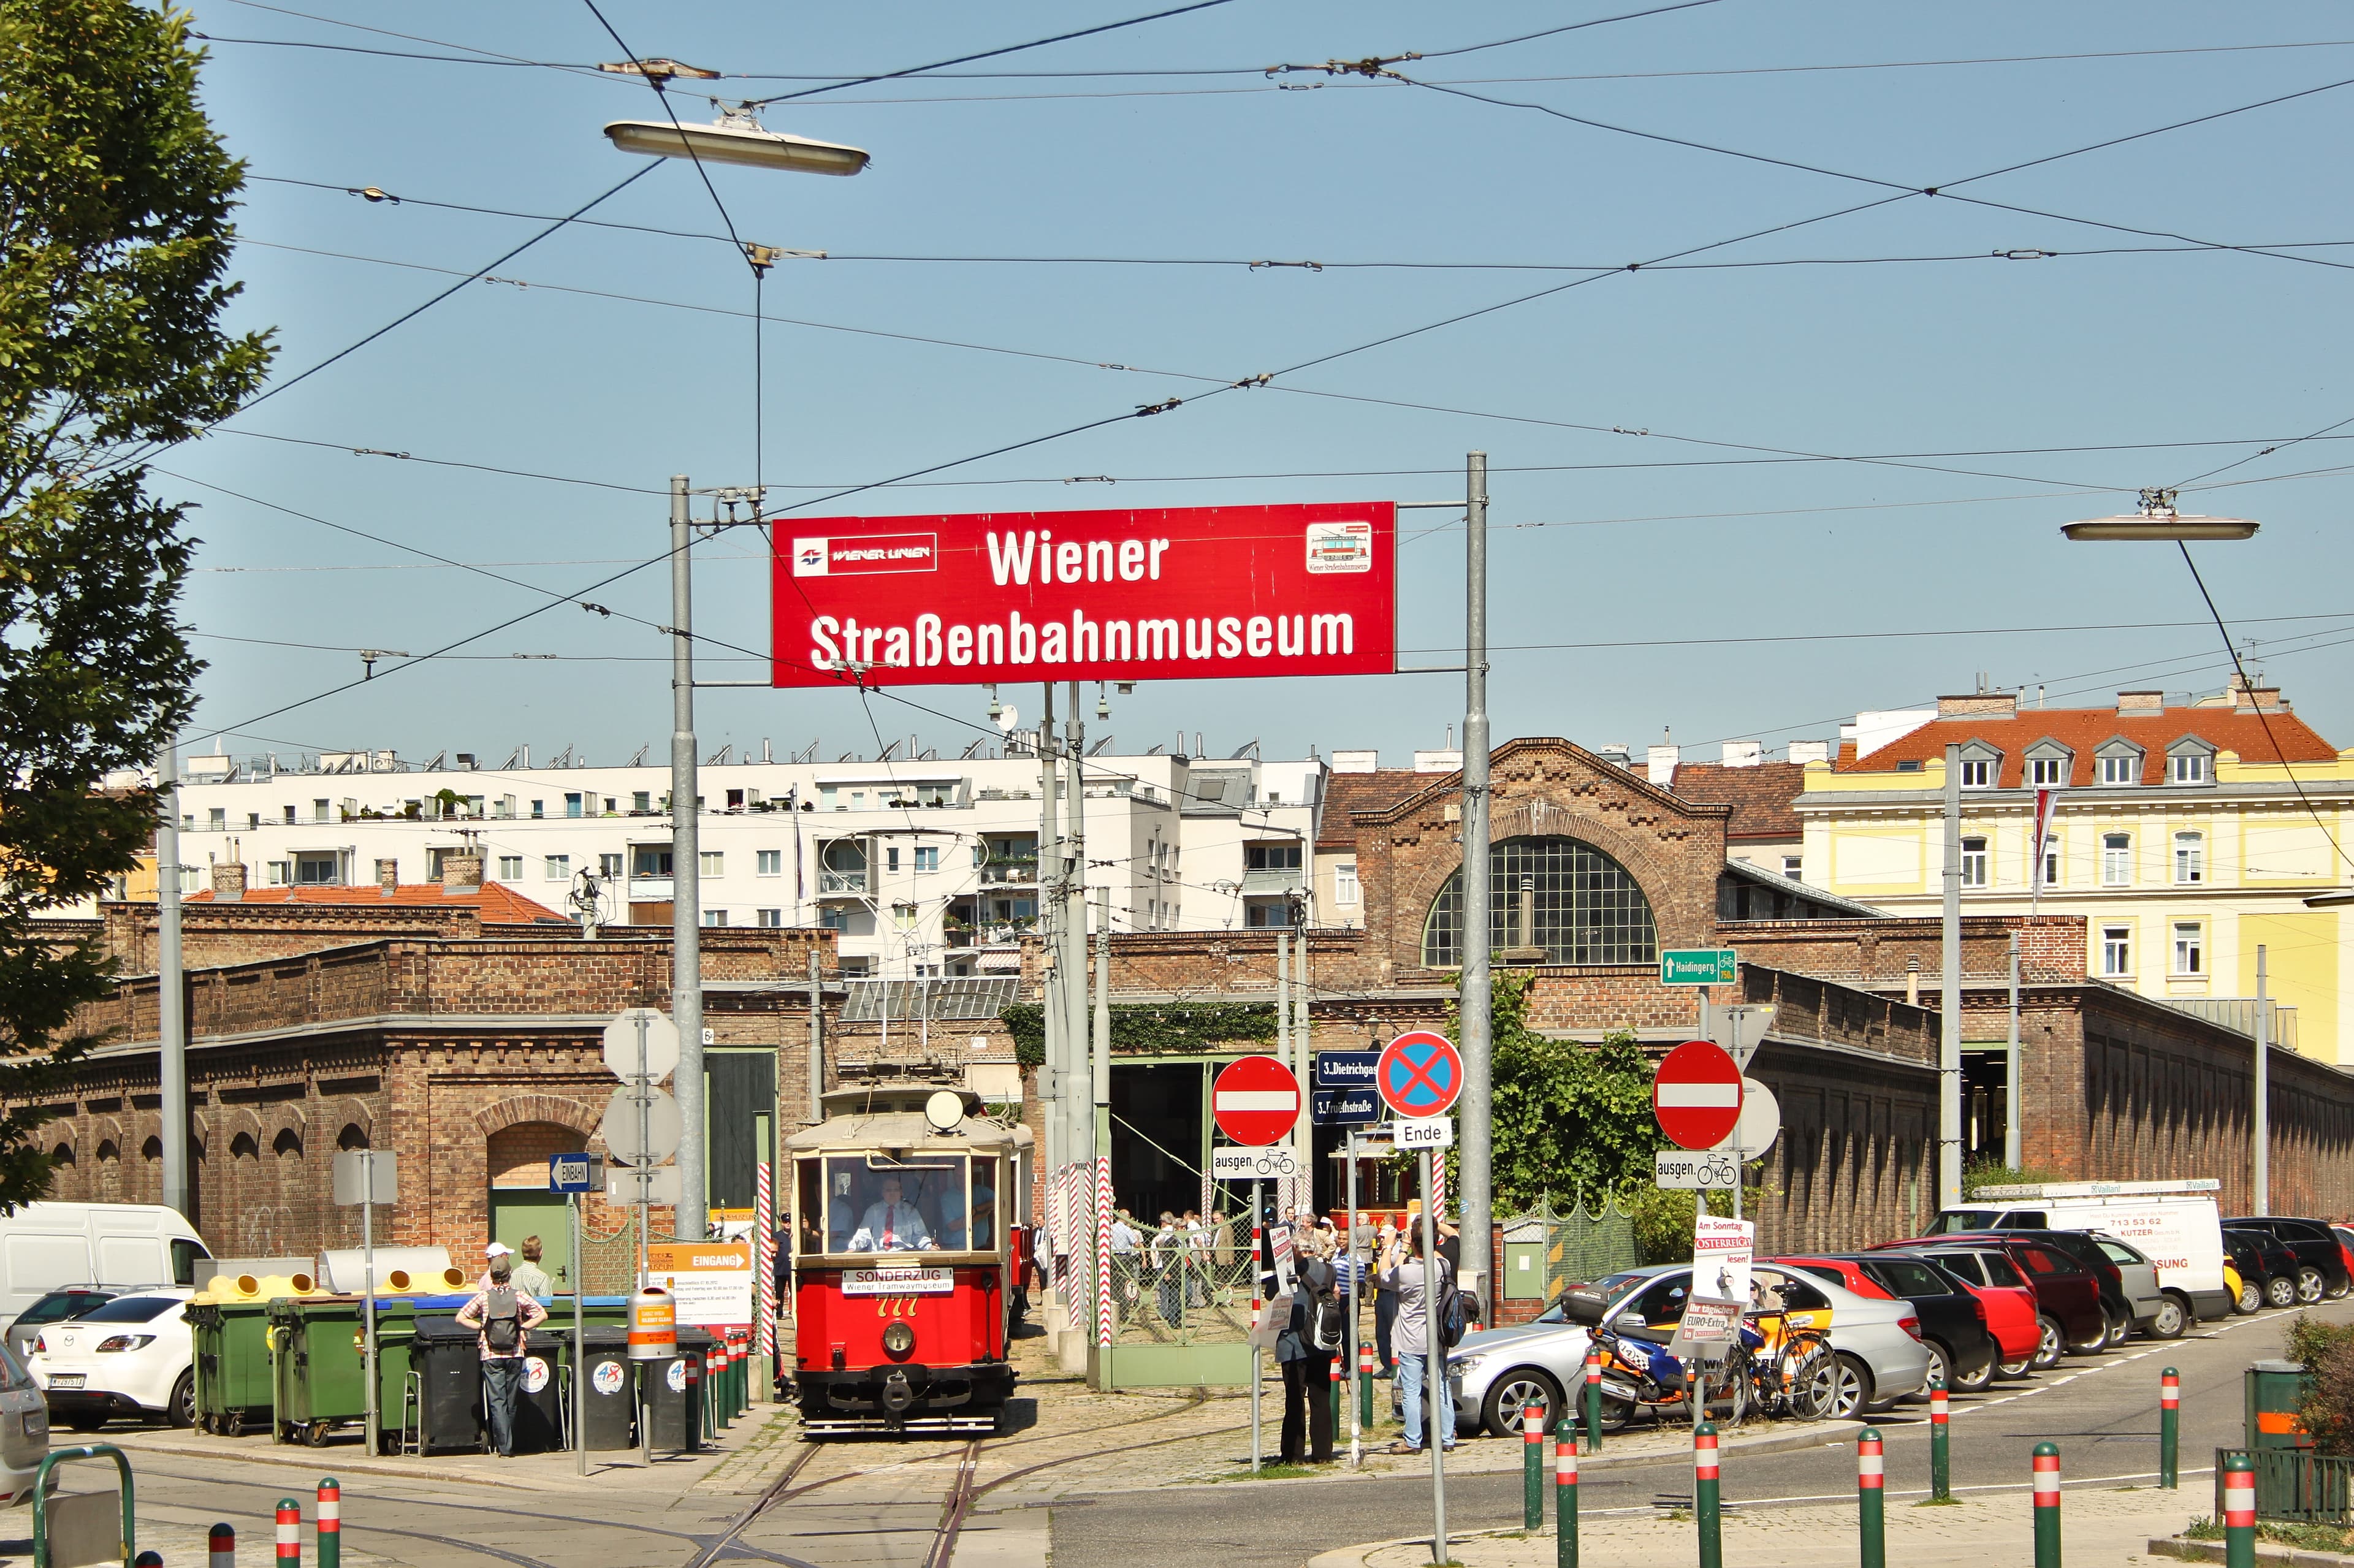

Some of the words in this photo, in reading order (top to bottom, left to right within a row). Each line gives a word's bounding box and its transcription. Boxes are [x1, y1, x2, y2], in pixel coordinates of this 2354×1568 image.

[832, 549, 886, 561] WIENER
[888, 546, 931, 559] LINIEN
[986, 530, 1169, 585] Wiener
[810, 609, 1353, 670] Straßenbahnmuseum
[1676, 961, 1716, 975] Haidingerg.
[1404, 1124, 1441, 1141] Ende
[1215, 1157, 1255, 1170] ausgen.
[562, 1165, 585, 1181] EINBAHN
[1658, 1162, 1696, 1179] ausgen.
[2097, 1184, 2121, 1193] Vaillant
[2192, 1181, 2215, 1189] Vaillant
[1713, 1221, 1742, 1232] Sonntag
[693, 1255, 736, 1266] EINGANG
[856, 1269, 941, 1282] SONDERZUG
[878, 1282, 950, 1292] Tramwaymuseum
[875, 1293, 920, 1317] 777
[1689, 1303, 1701, 1312] Ihr
[1702, 1304, 1735, 1315] tägliches
[1687, 1316, 1725, 1328] EURO-Extra
[1685, 1329, 1692, 1338] in
